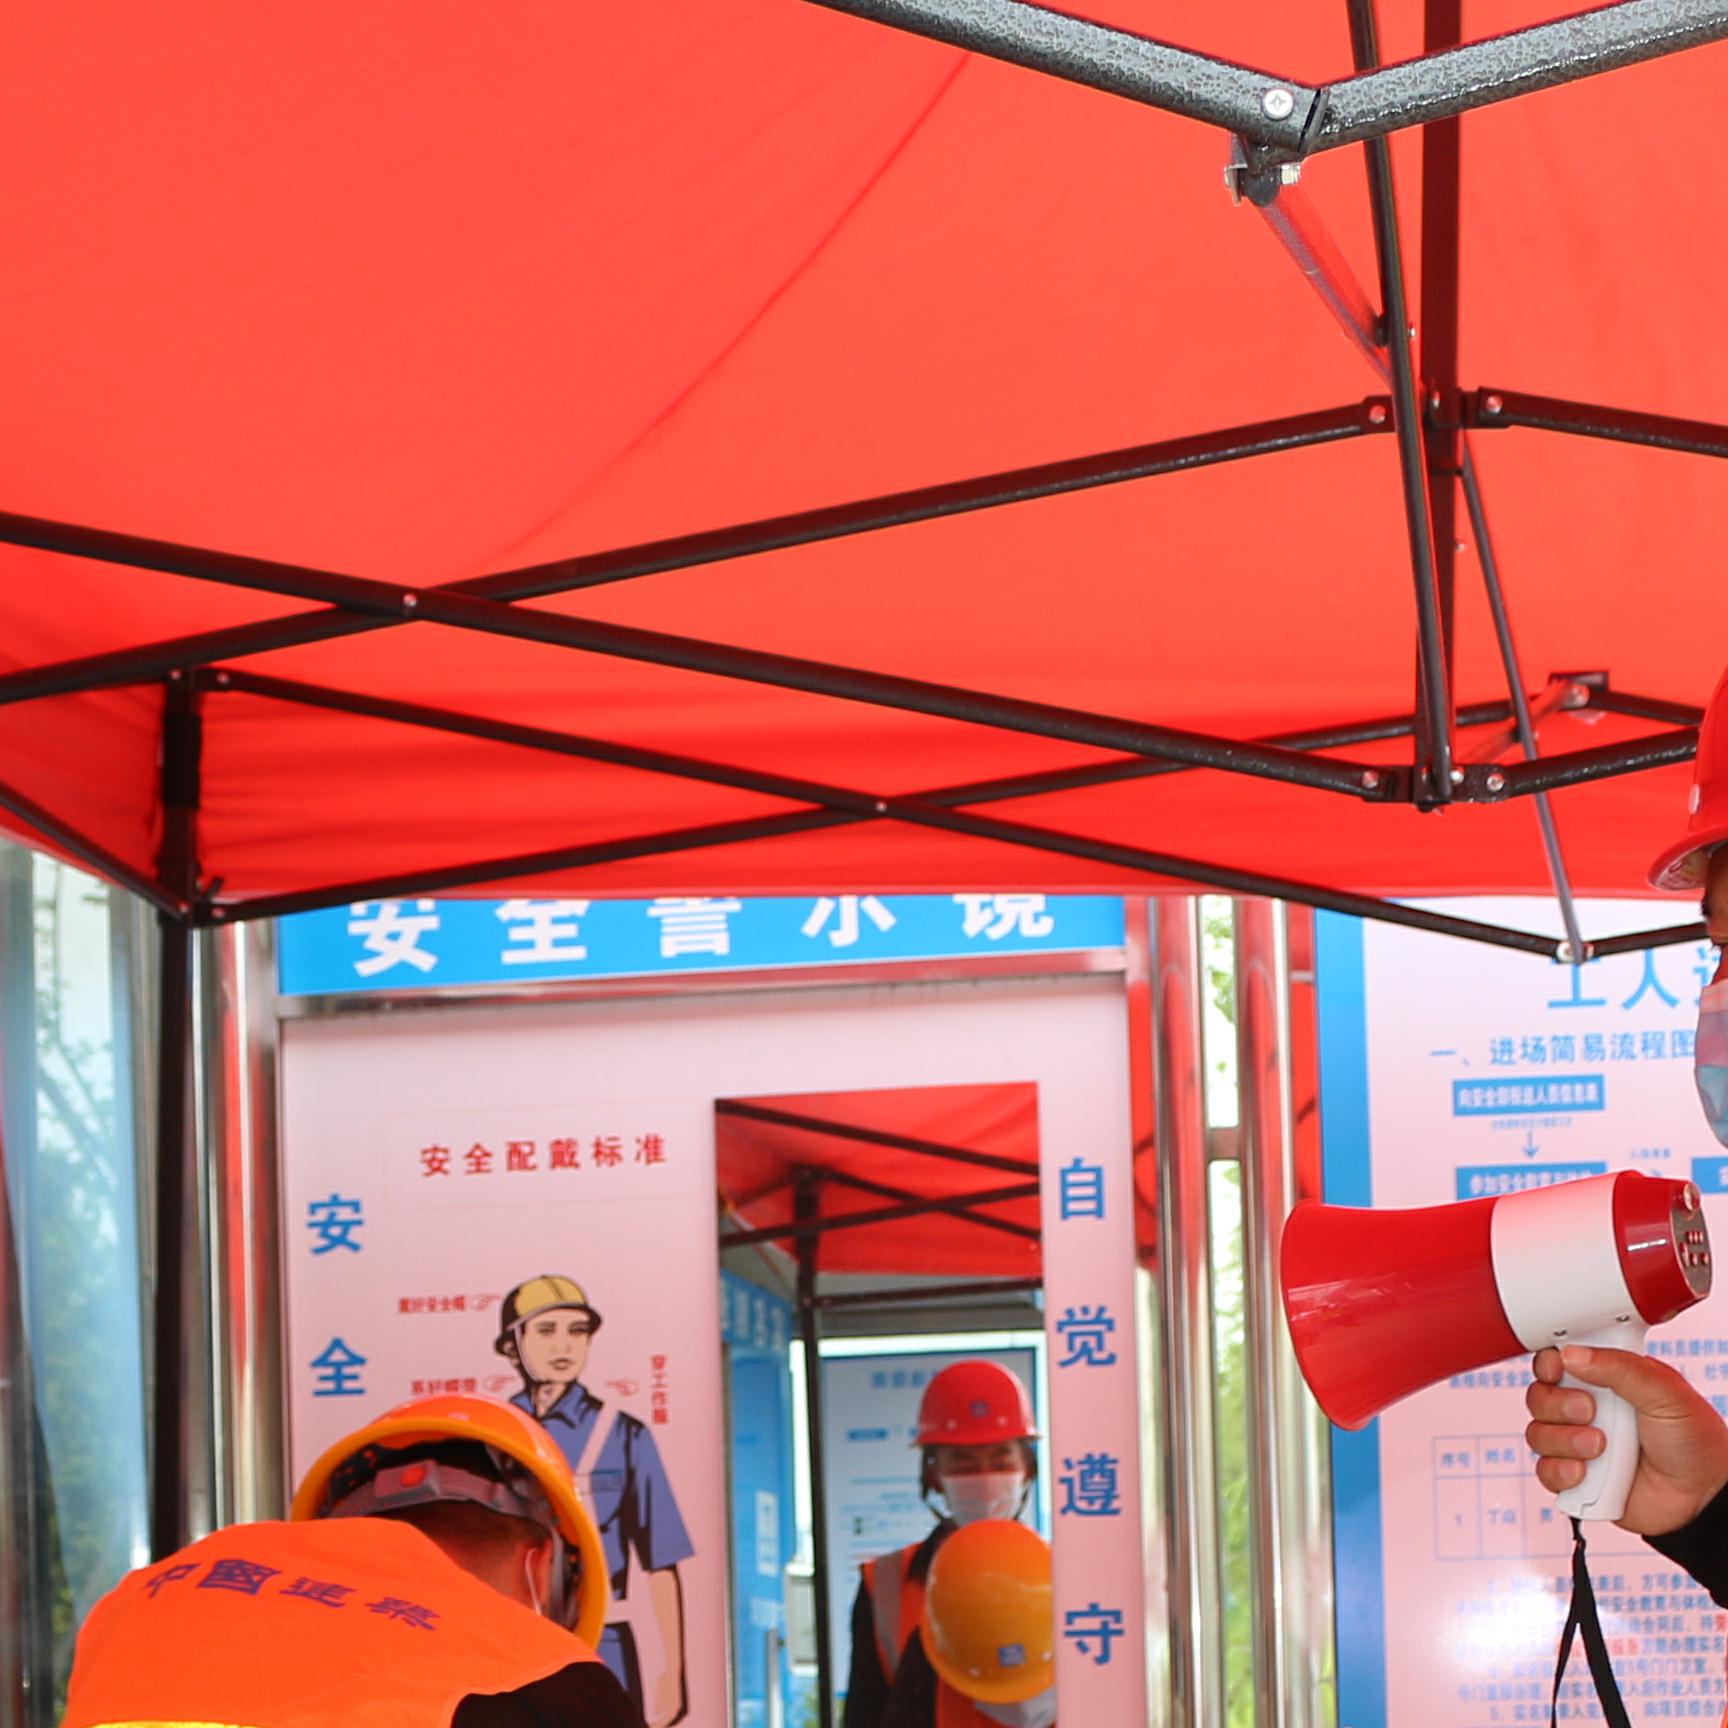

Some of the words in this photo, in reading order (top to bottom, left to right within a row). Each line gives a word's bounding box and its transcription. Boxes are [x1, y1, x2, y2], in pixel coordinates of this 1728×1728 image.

[420, 1134, 666, 1178] 安全配戴标准
[305, 1192, 368, 1398] 安全
